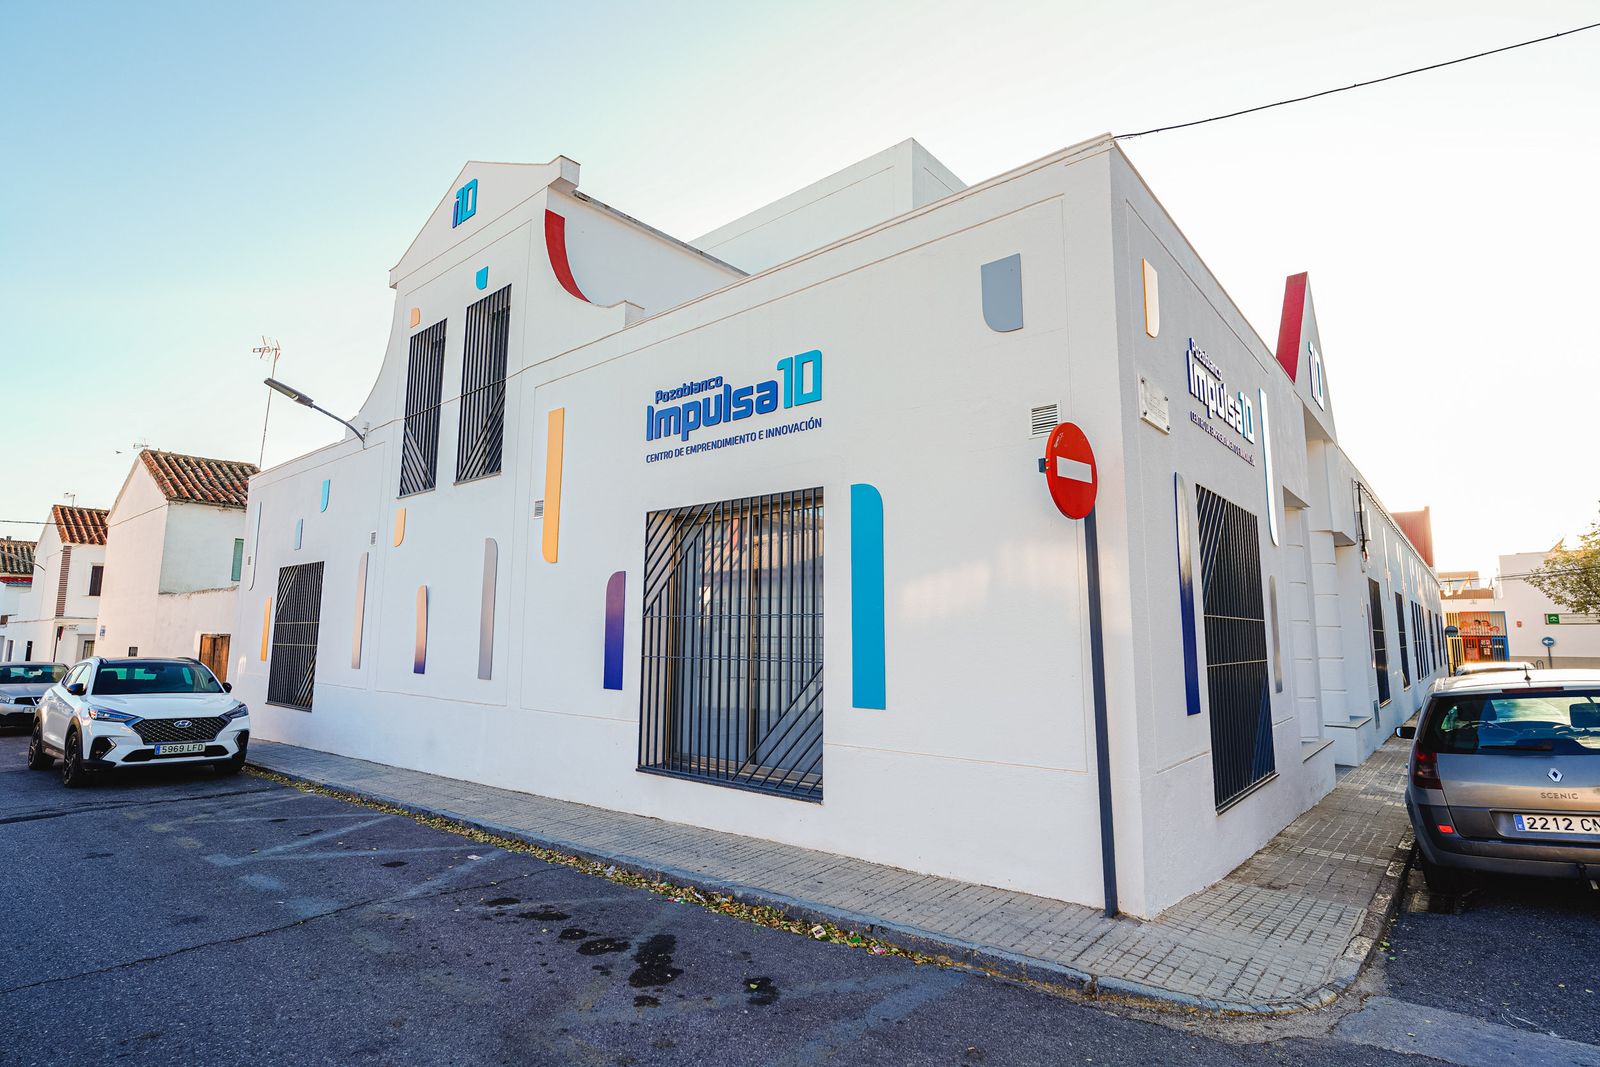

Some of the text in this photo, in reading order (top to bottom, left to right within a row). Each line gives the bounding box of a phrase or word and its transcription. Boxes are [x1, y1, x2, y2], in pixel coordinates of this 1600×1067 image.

[655, 376, 723, 404] Pozoblanco
[646, 416, 823, 463] CENTRO DE EMPRENDIMIENTO E INNOVACIÓN
[161, 745, 184, 754] 5969
[1540, 792, 1579, 800] SCENIC
[1526, 816, 1575, 831] 2212
